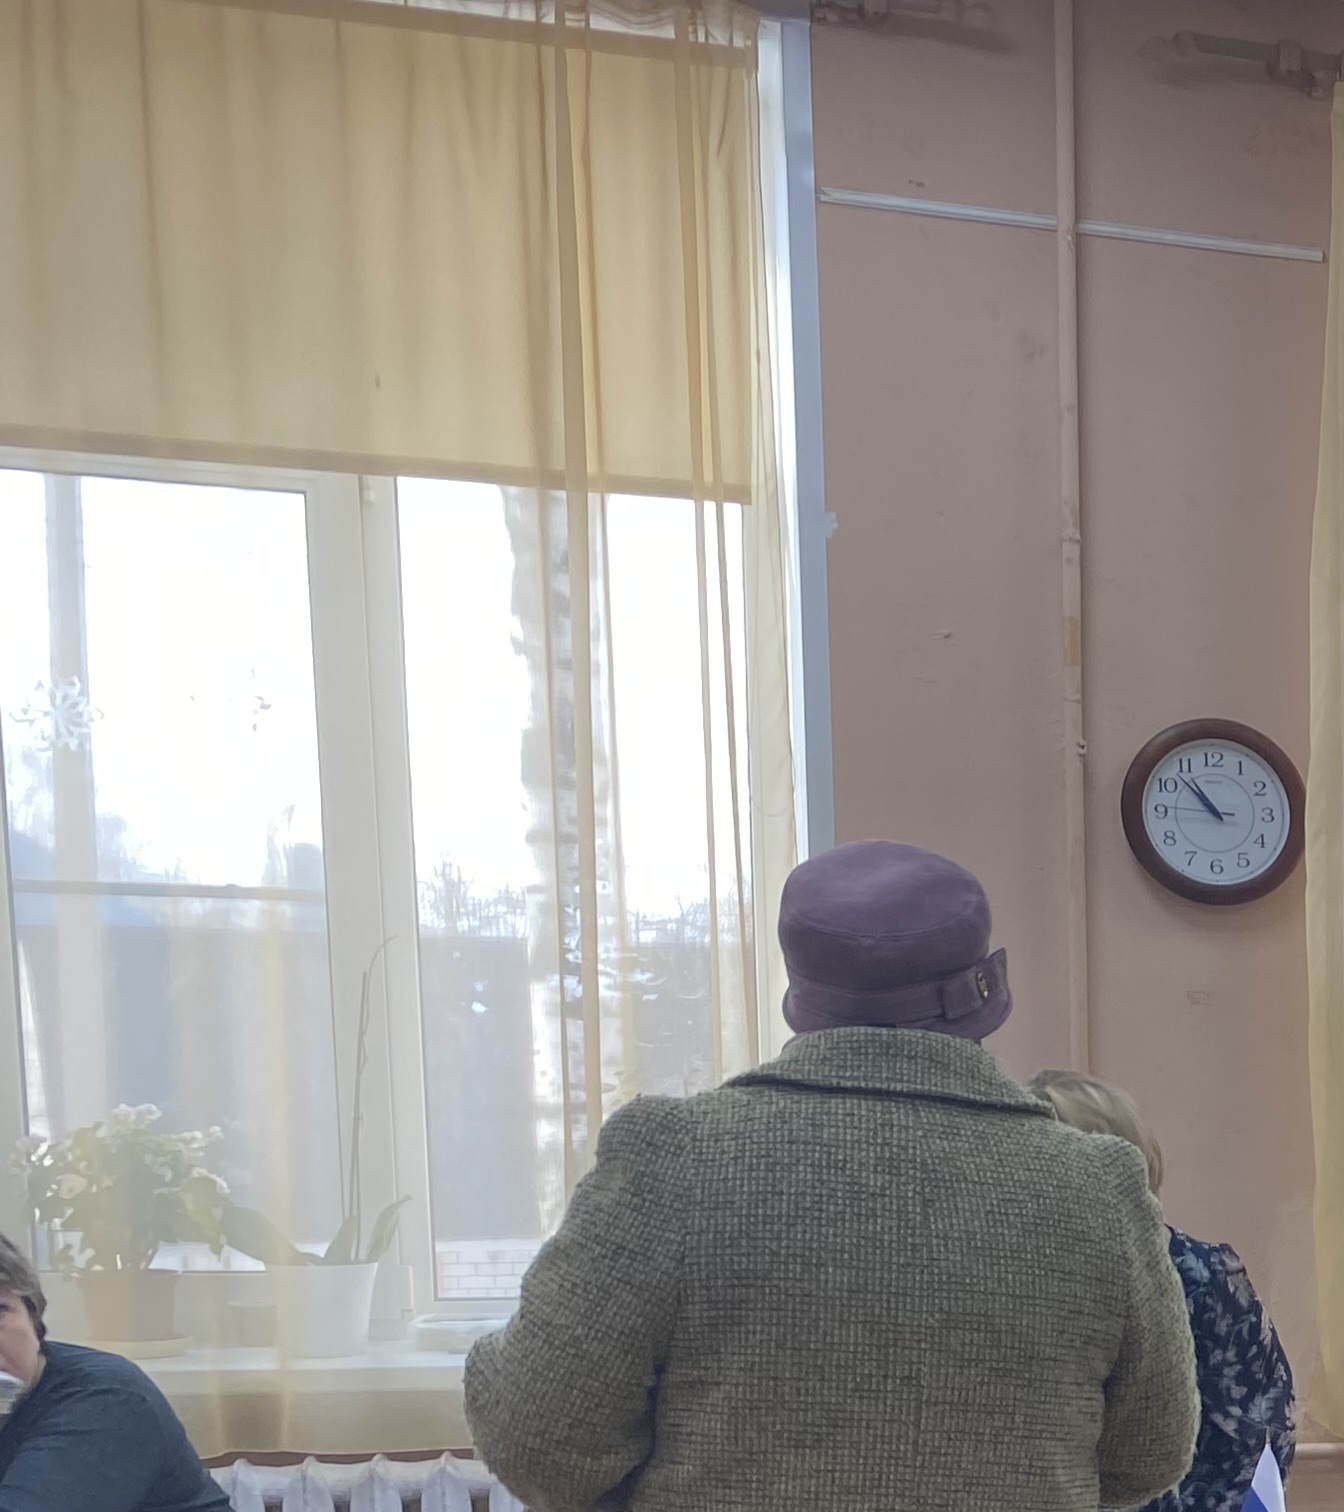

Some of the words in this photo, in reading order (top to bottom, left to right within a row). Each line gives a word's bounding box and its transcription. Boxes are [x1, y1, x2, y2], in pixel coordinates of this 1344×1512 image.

[1178, 757, 1193, 773] 11
[1203, 752, 1224, 768] 12
[1237, 760, 1244, 776] 1
[1157, 777, 1178, 793] 10
[1253, 781, 1267, 797] 2
[1154, 804, 1168, 820] 9
[1261, 807, 1275, 823] 3
[1163, 831, 1177, 846] 8
[1253, 833, 1267, 849] 4
[1184, 851, 1197, 866] 7
[1237, 852, 1250, 868] 5
[1210, 859, 1224, 875] 6
